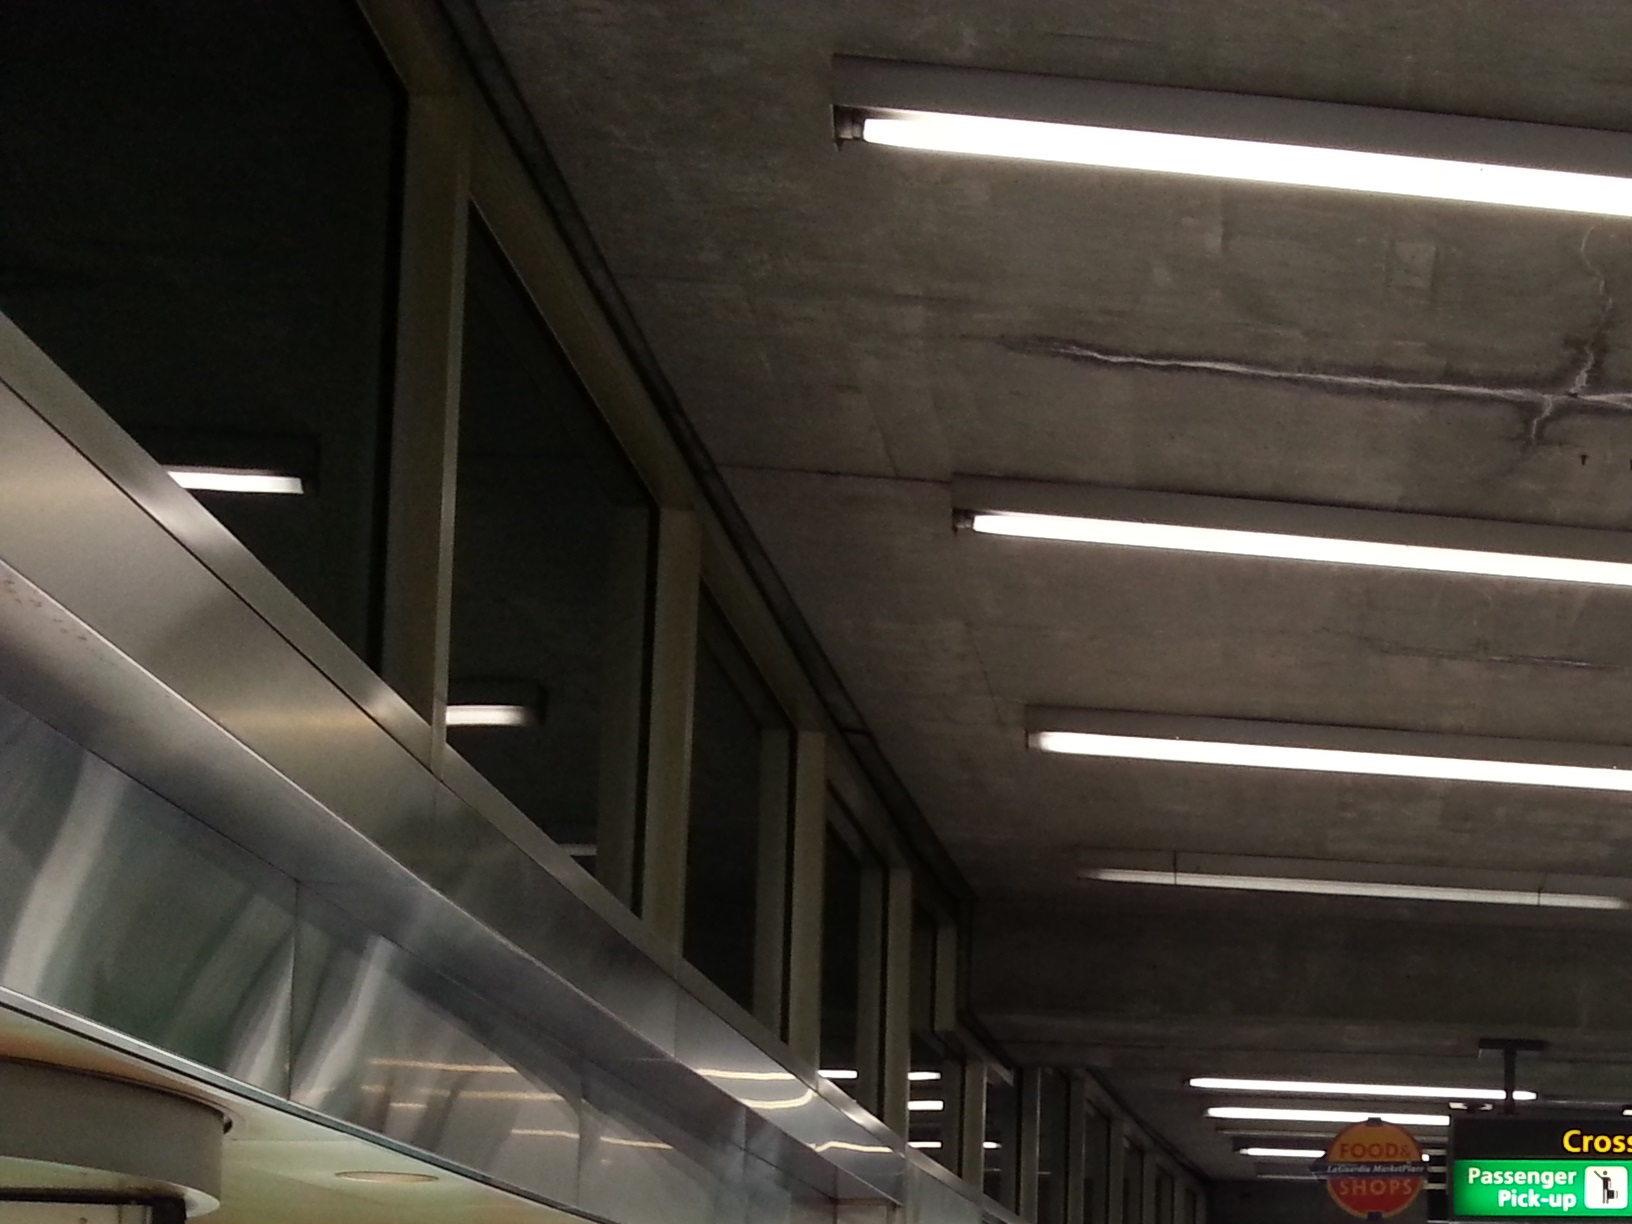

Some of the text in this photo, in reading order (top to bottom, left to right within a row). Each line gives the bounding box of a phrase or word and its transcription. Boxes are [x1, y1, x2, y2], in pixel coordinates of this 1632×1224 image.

[1340, 1179, 1412, 1195] SHOPS
[1468, 1168, 1577, 1188] Passenger
[1499, 1189, 1577, 1210] Pick-up
